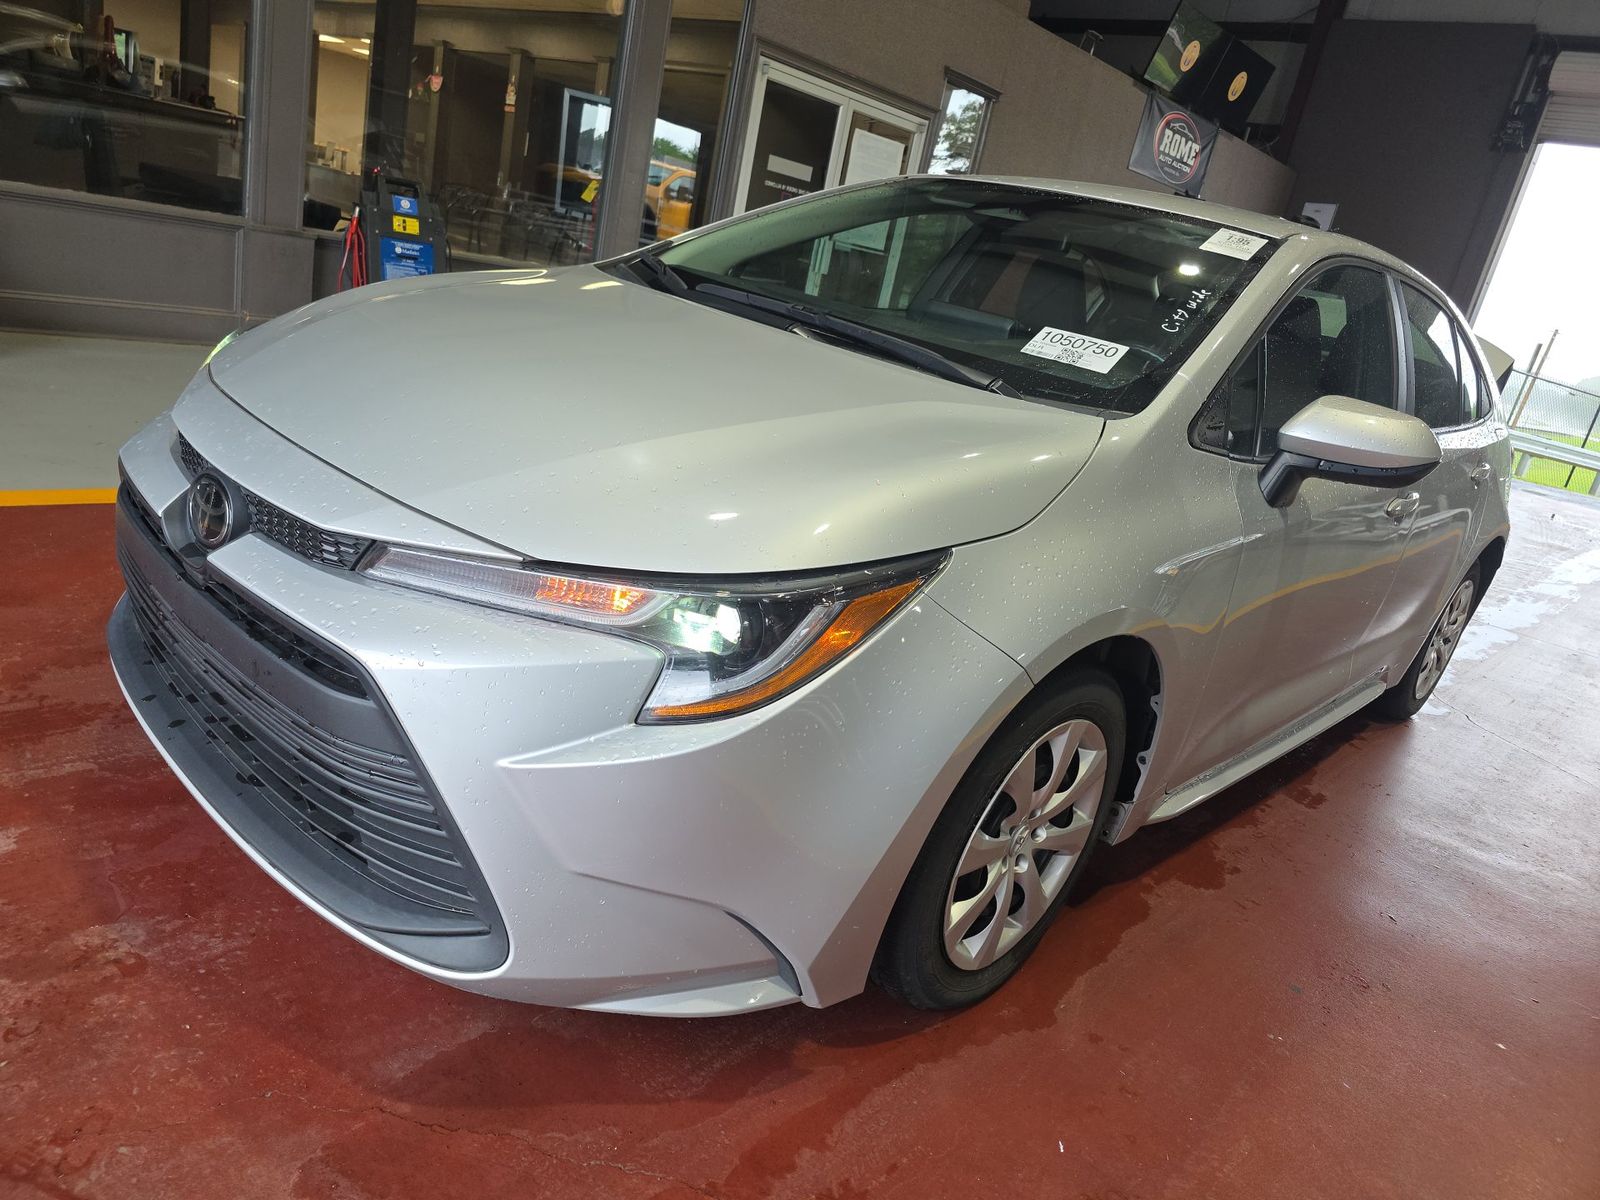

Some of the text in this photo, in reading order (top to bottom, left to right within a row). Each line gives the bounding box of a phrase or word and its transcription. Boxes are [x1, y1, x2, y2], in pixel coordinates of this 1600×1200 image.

[1160, 128, 1200, 166] ROME
[1159, 154, 1173, 165] AUTO
[1172, 160, 1191, 174] AUCTION
[1161, 309, 1189, 333] City
[1041, 331, 1119, 358] 1050750
